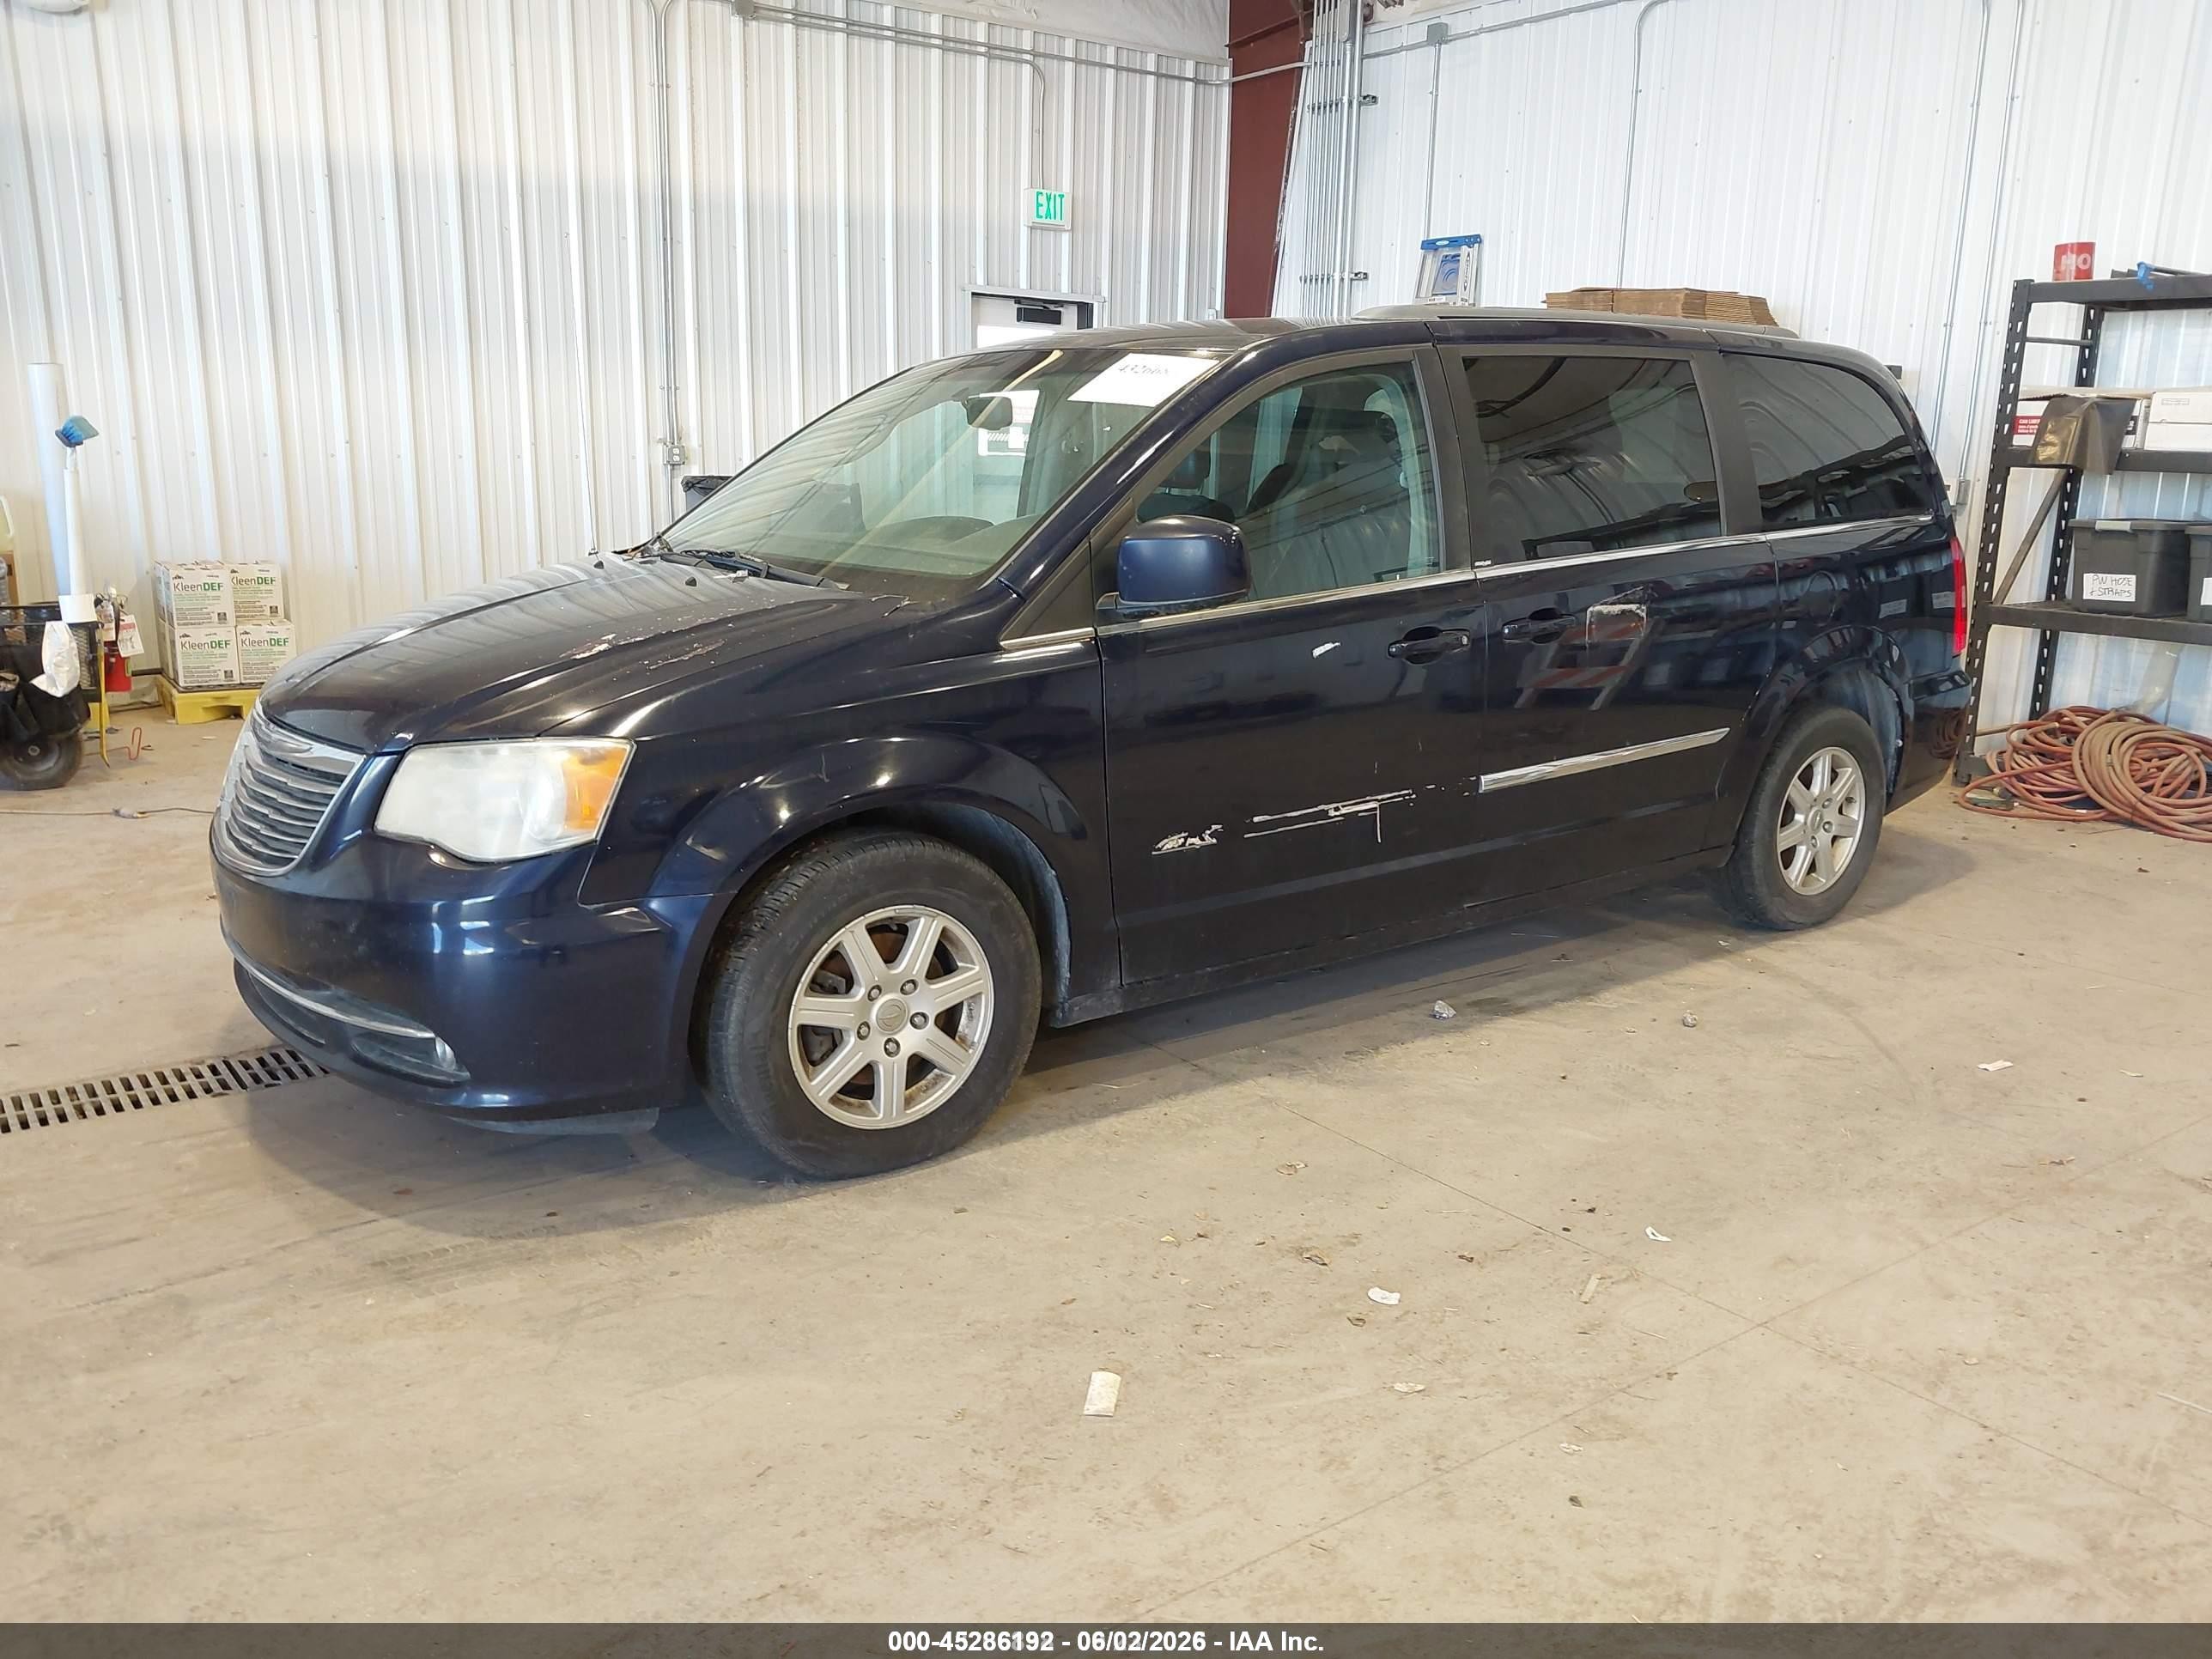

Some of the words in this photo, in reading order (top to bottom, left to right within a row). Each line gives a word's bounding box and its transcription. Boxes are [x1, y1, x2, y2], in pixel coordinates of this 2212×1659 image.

[1036, 191, 1065, 221] EXIT
[173, 581, 223, 592] KleenDEF
[2112, 577, 2133, 586] HOSE
[2098, 586, 2132, 598] STRAPS
[180, 639, 231, 651] KleenDEF
[240, 637, 289, 647] KleenDEF
